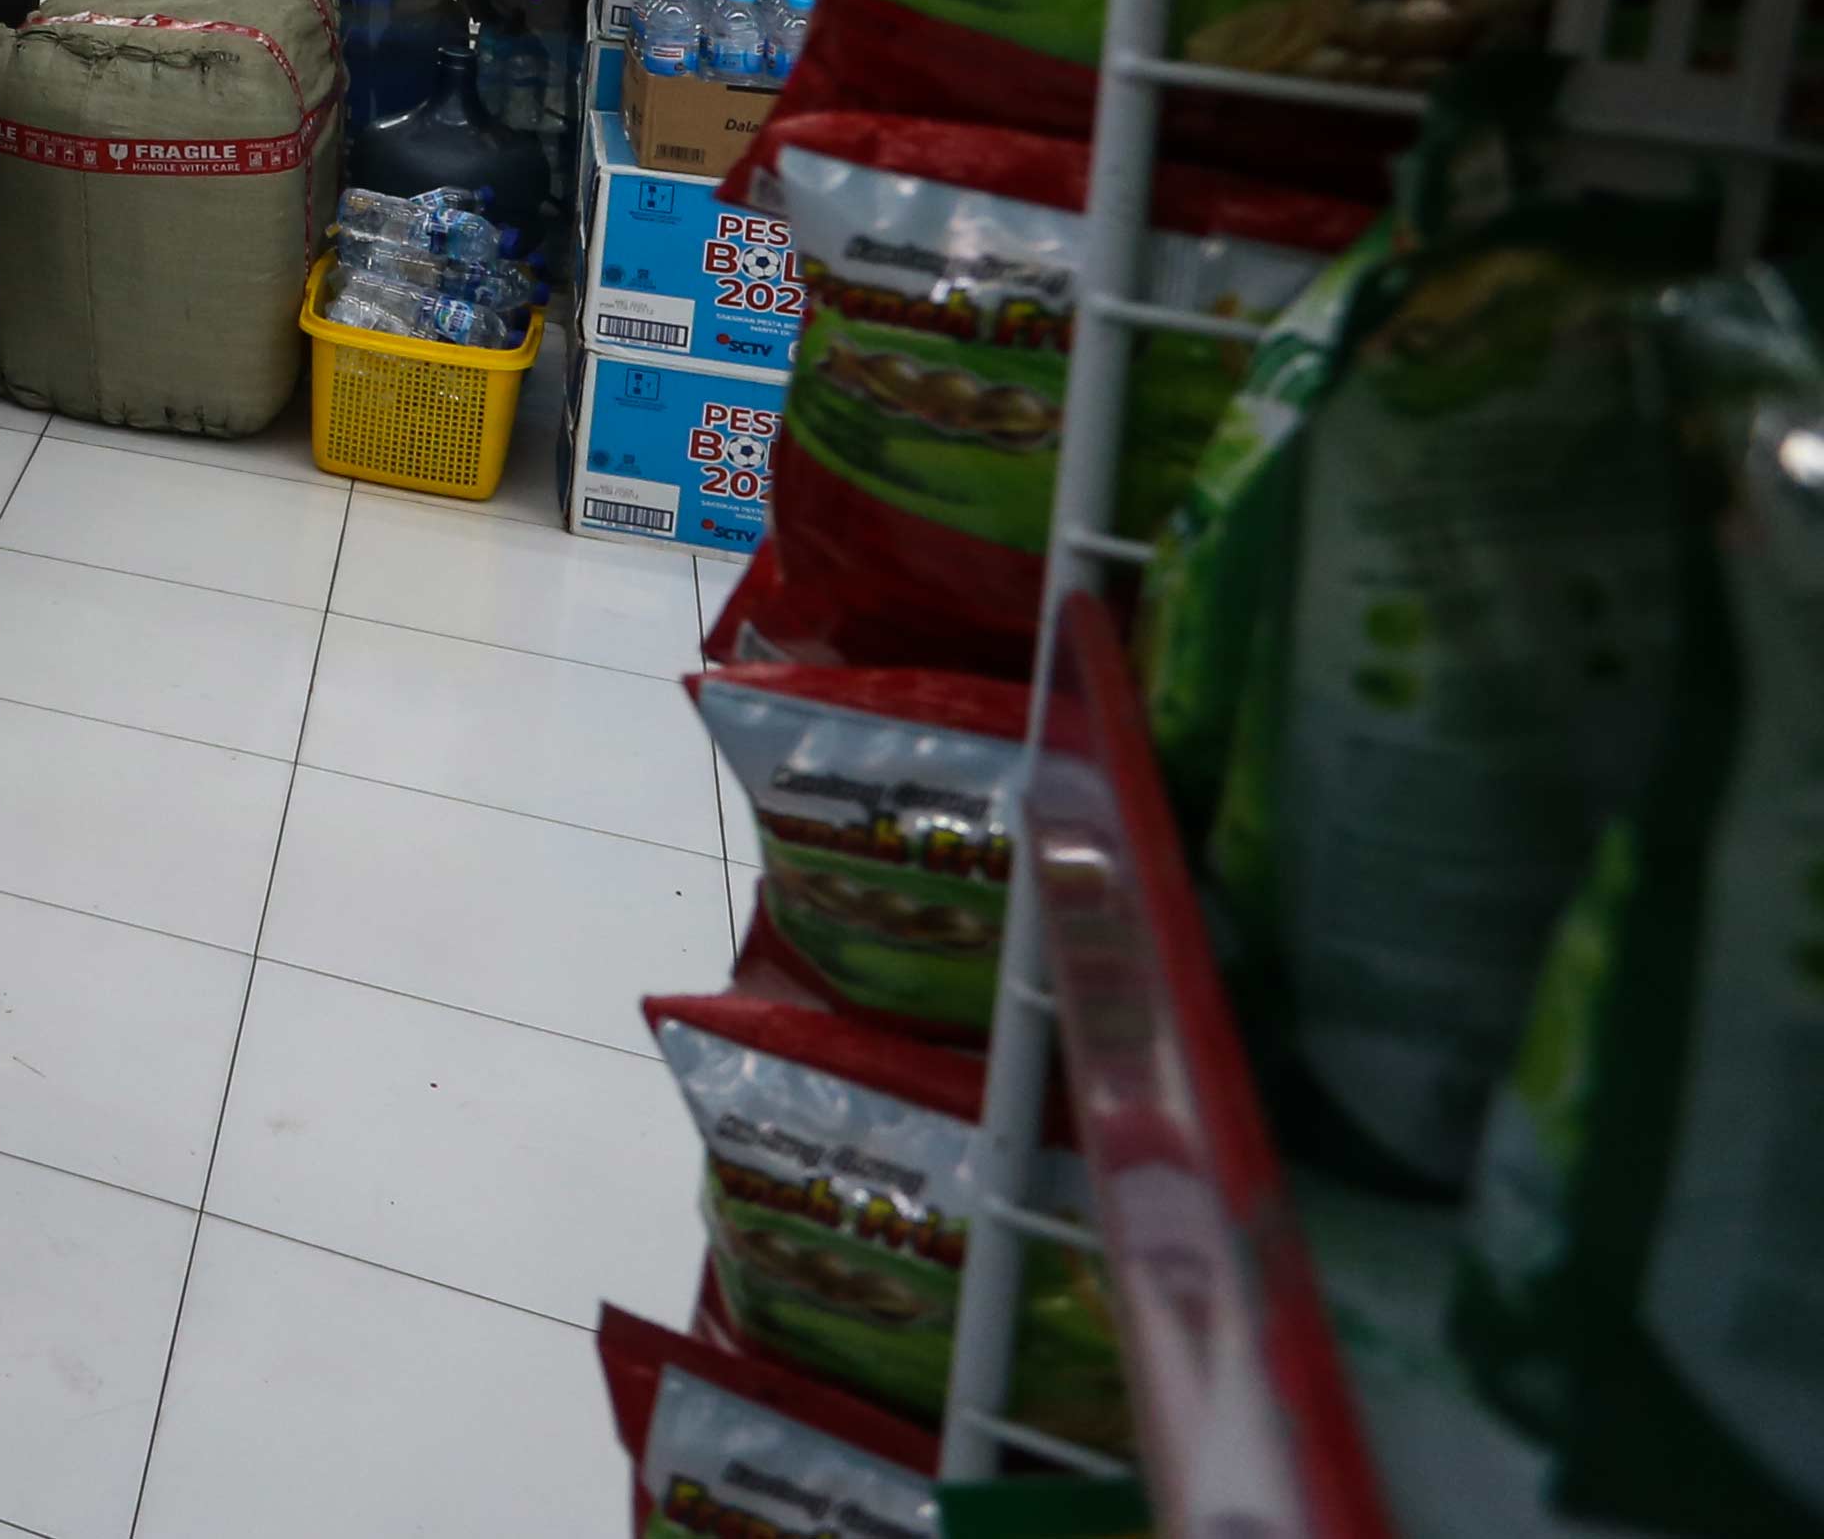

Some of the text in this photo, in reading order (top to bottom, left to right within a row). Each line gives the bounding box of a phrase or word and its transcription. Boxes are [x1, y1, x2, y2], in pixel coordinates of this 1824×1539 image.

[135, 144, 237, 160] FRAGILE
[133, 163, 240, 172] HANDLE WITH CARE
[729, 339, 774, 357] SCTV
[713, 527, 756, 542] SCTV
